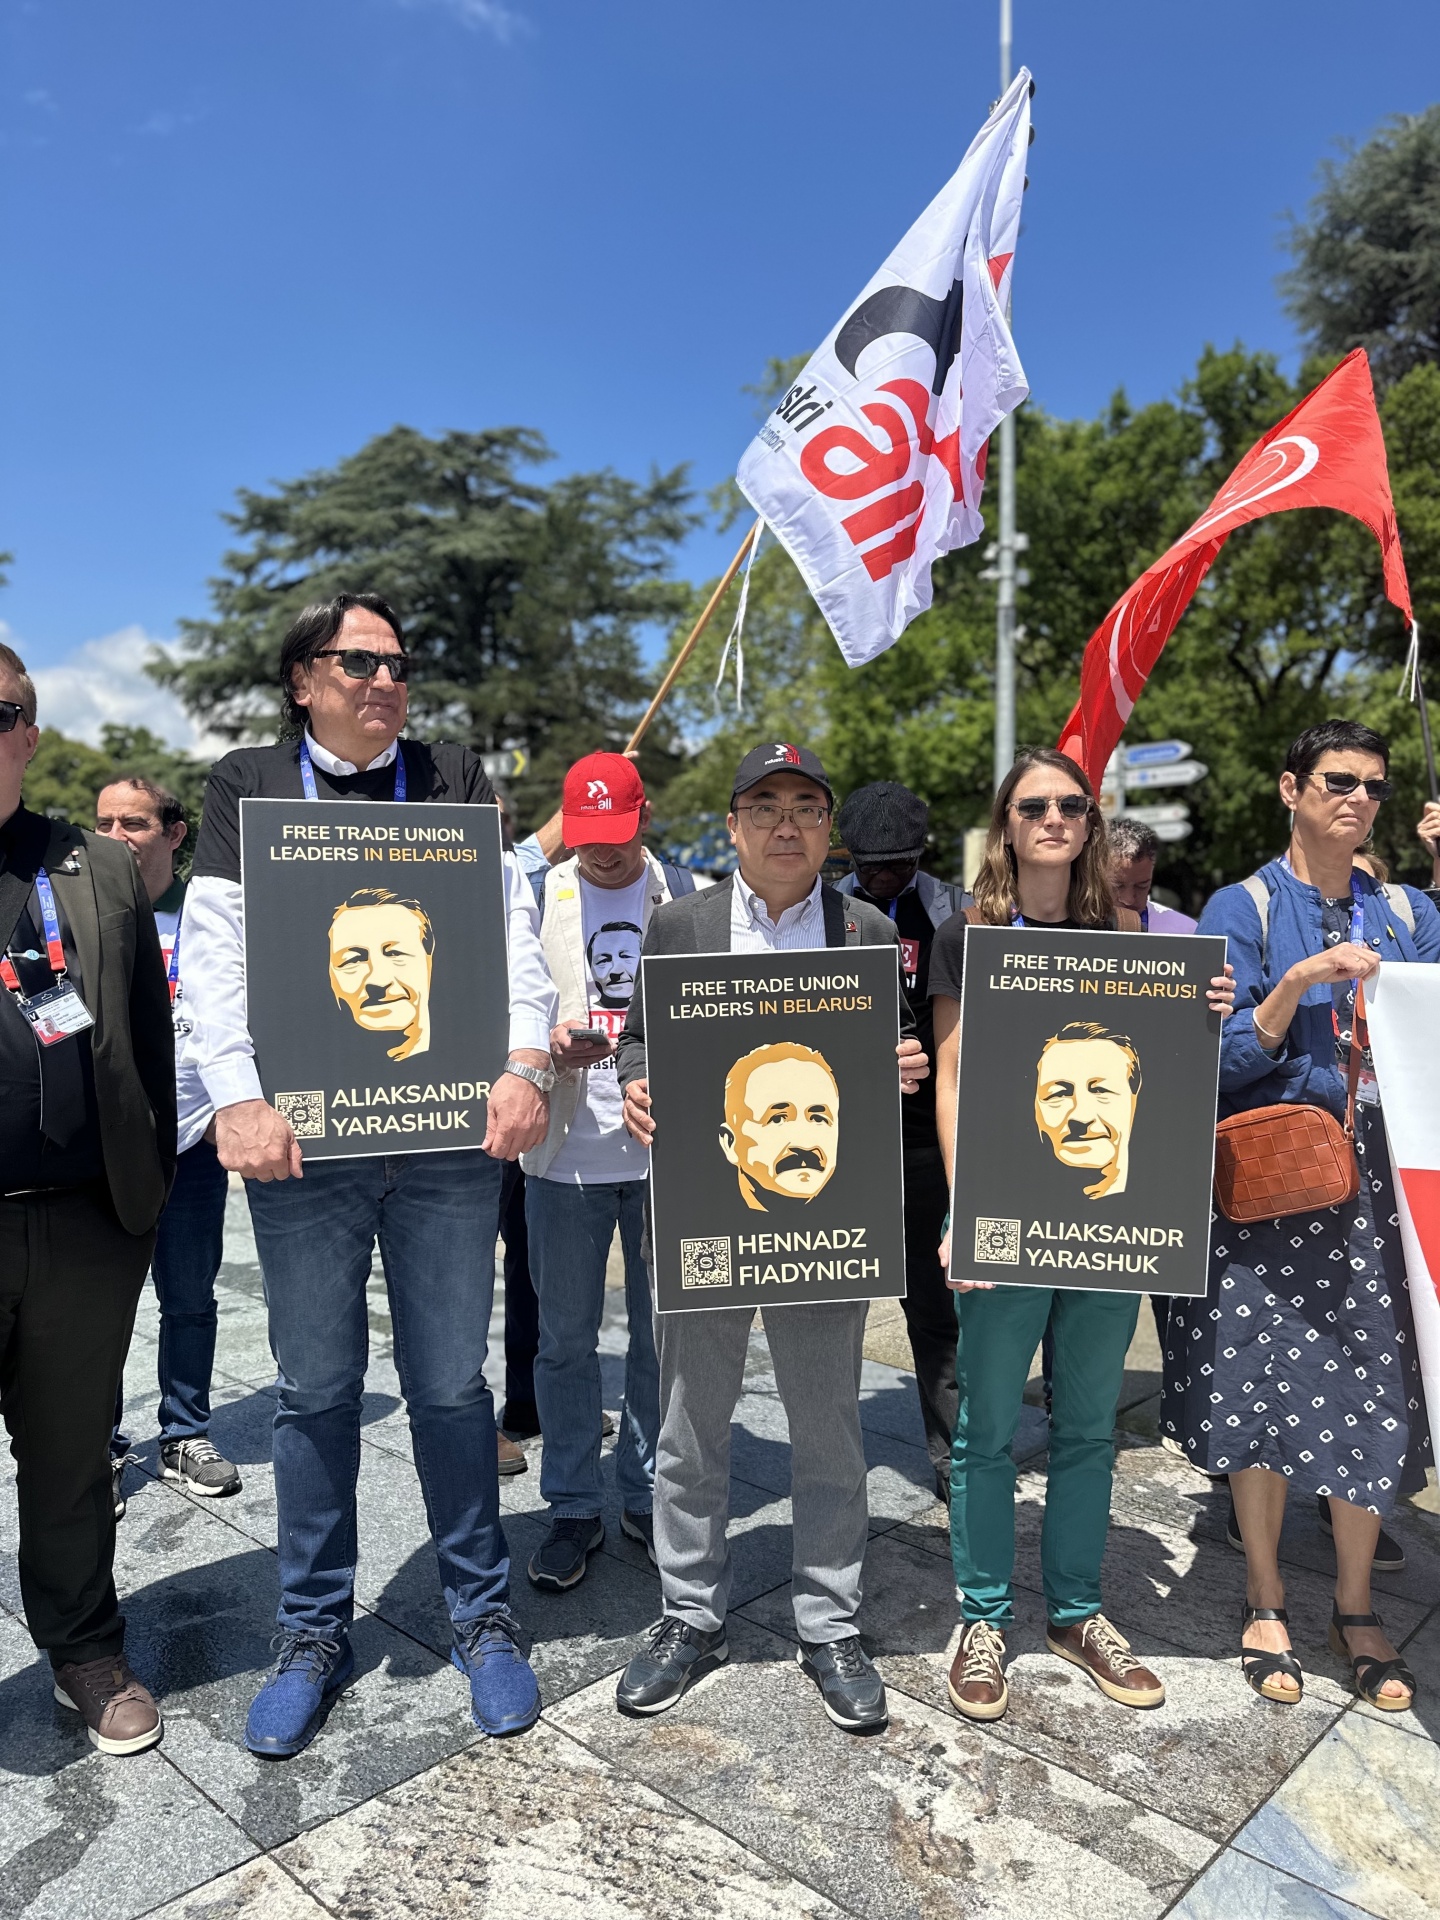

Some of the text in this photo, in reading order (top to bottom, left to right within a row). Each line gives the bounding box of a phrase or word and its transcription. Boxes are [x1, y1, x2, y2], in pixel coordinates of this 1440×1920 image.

[282, 825, 465, 842] FREE TRADE UNION
[270, 845, 477, 863] LEADERS IN BELARUS!
[1003, 953, 1186, 977] FREE TRADE UNION
[681, 974, 859, 997] FREE TRADE UNION
[989, 974, 1198, 999] LEADERS IN BELARUS!
[670, 995, 872, 1020] LEADERS IN BELARUS!
[330, 1081, 491, 1109] ALIAKSANDR
[330, 1109, 471, 1138] YARASHUK
[738, 1227, 867, 1255] HENNADZ
[1025, 1220, 1185, 1249] ALIAKSANDR
[739, 1257, 880, 1286] FIADYNICH
[1024, 1247, 1160, 1275] YARASHUK
